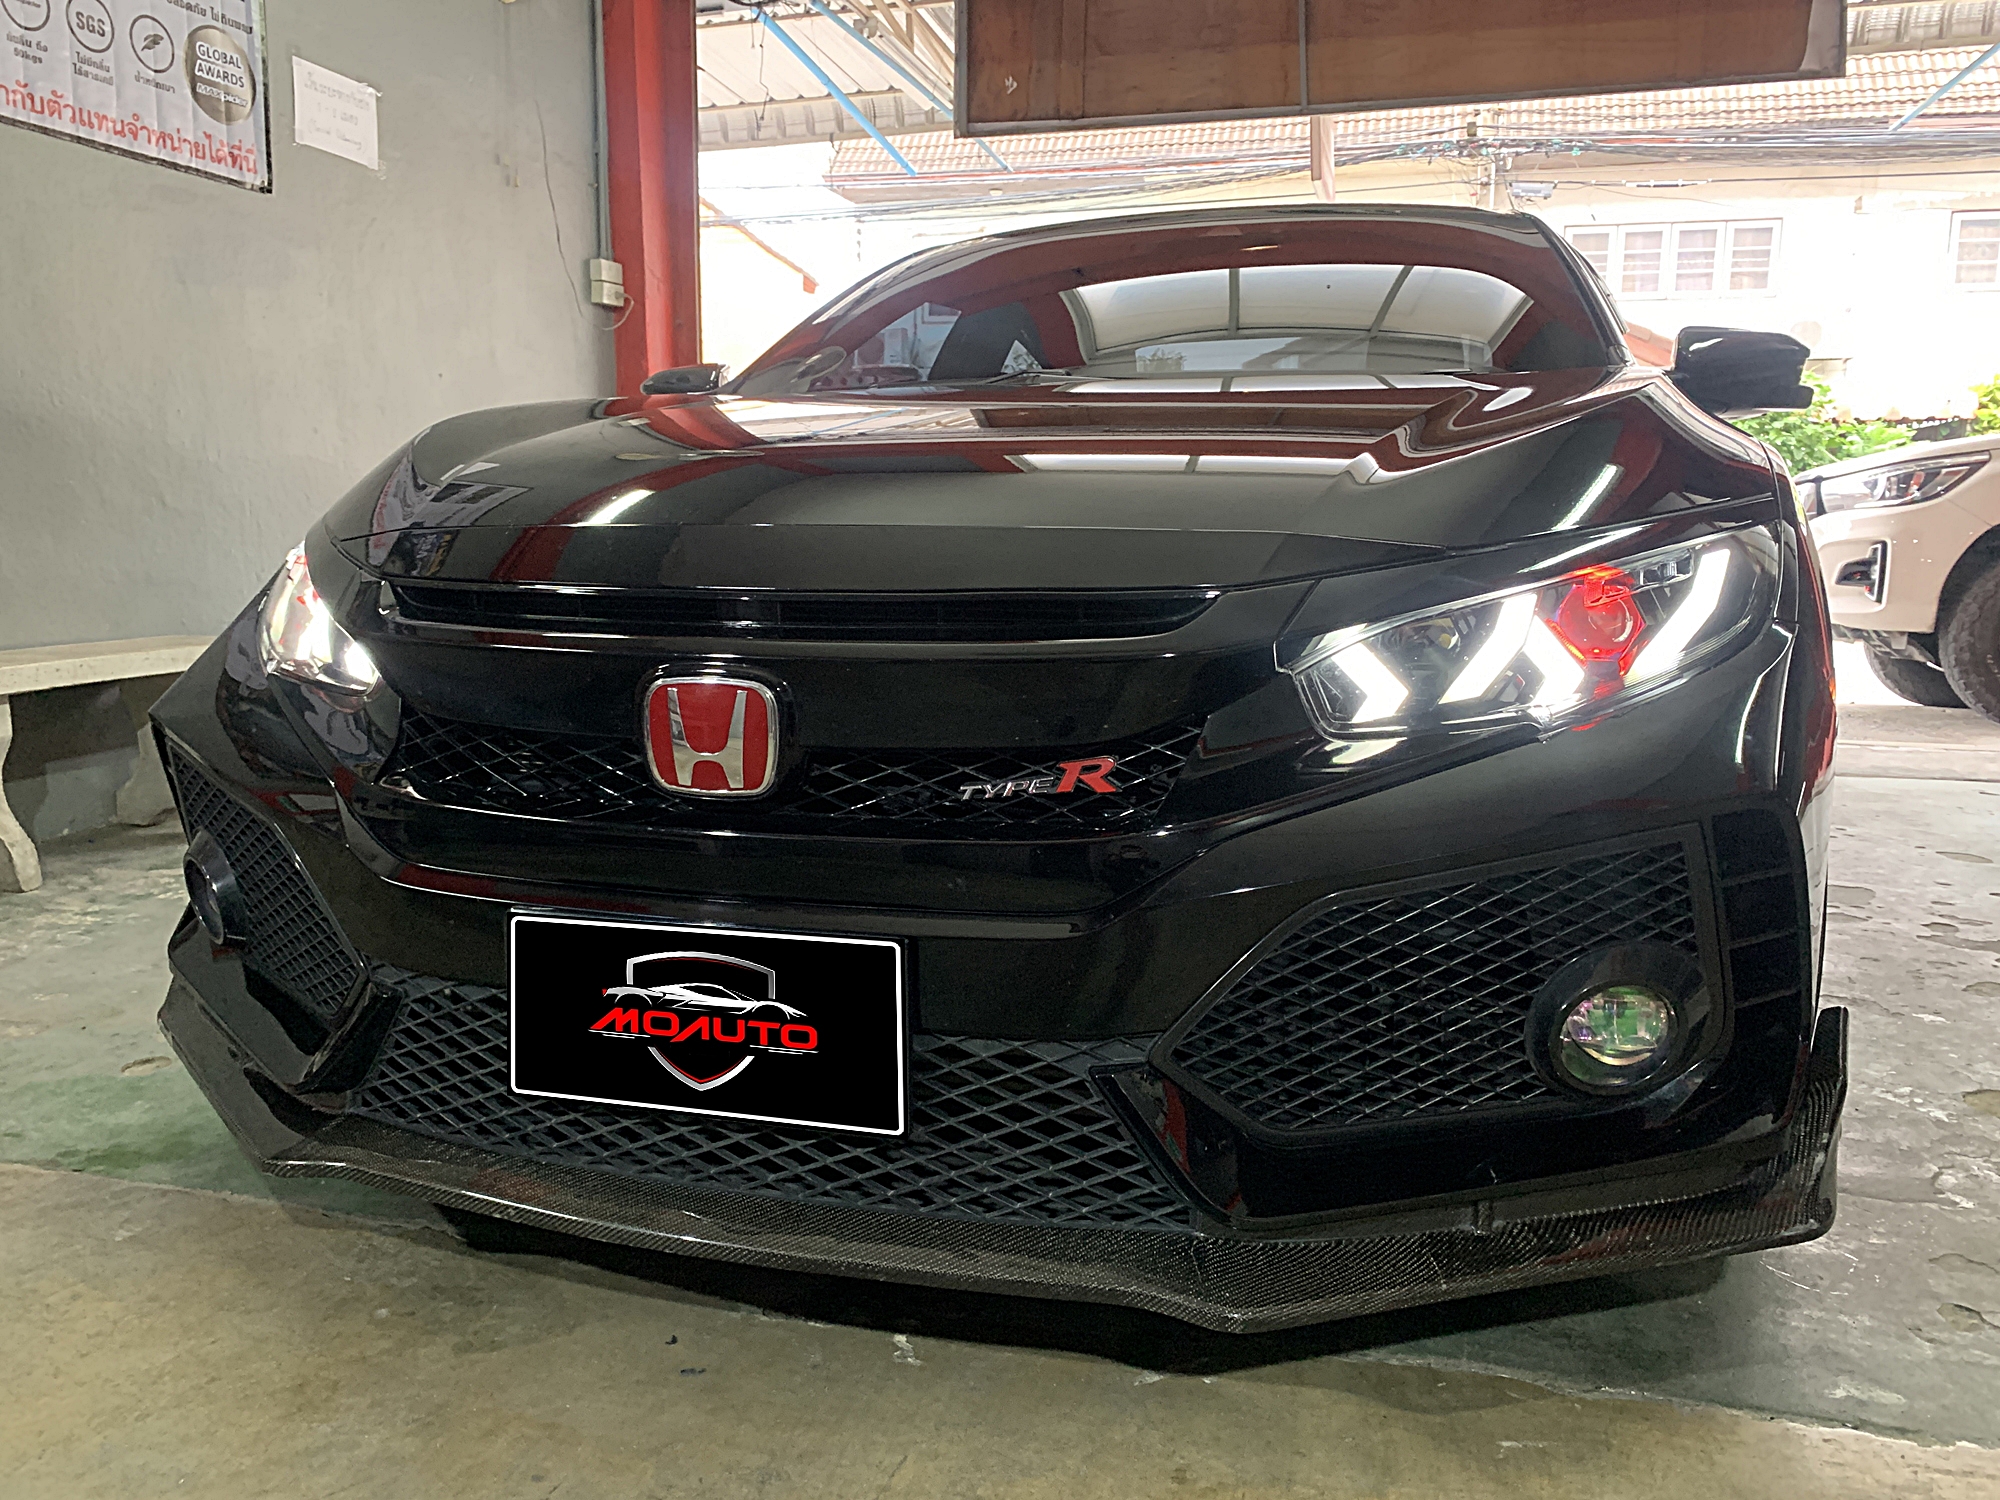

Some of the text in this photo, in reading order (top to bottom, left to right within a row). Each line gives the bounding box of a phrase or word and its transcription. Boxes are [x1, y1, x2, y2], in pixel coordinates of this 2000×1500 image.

[75, 11, 106, 38] SGS
[198, 43, 242, 70] GLOBAL
[197, 61, 245, 88] AWARDS
[959, 755, 1122, 801] TYPE R
